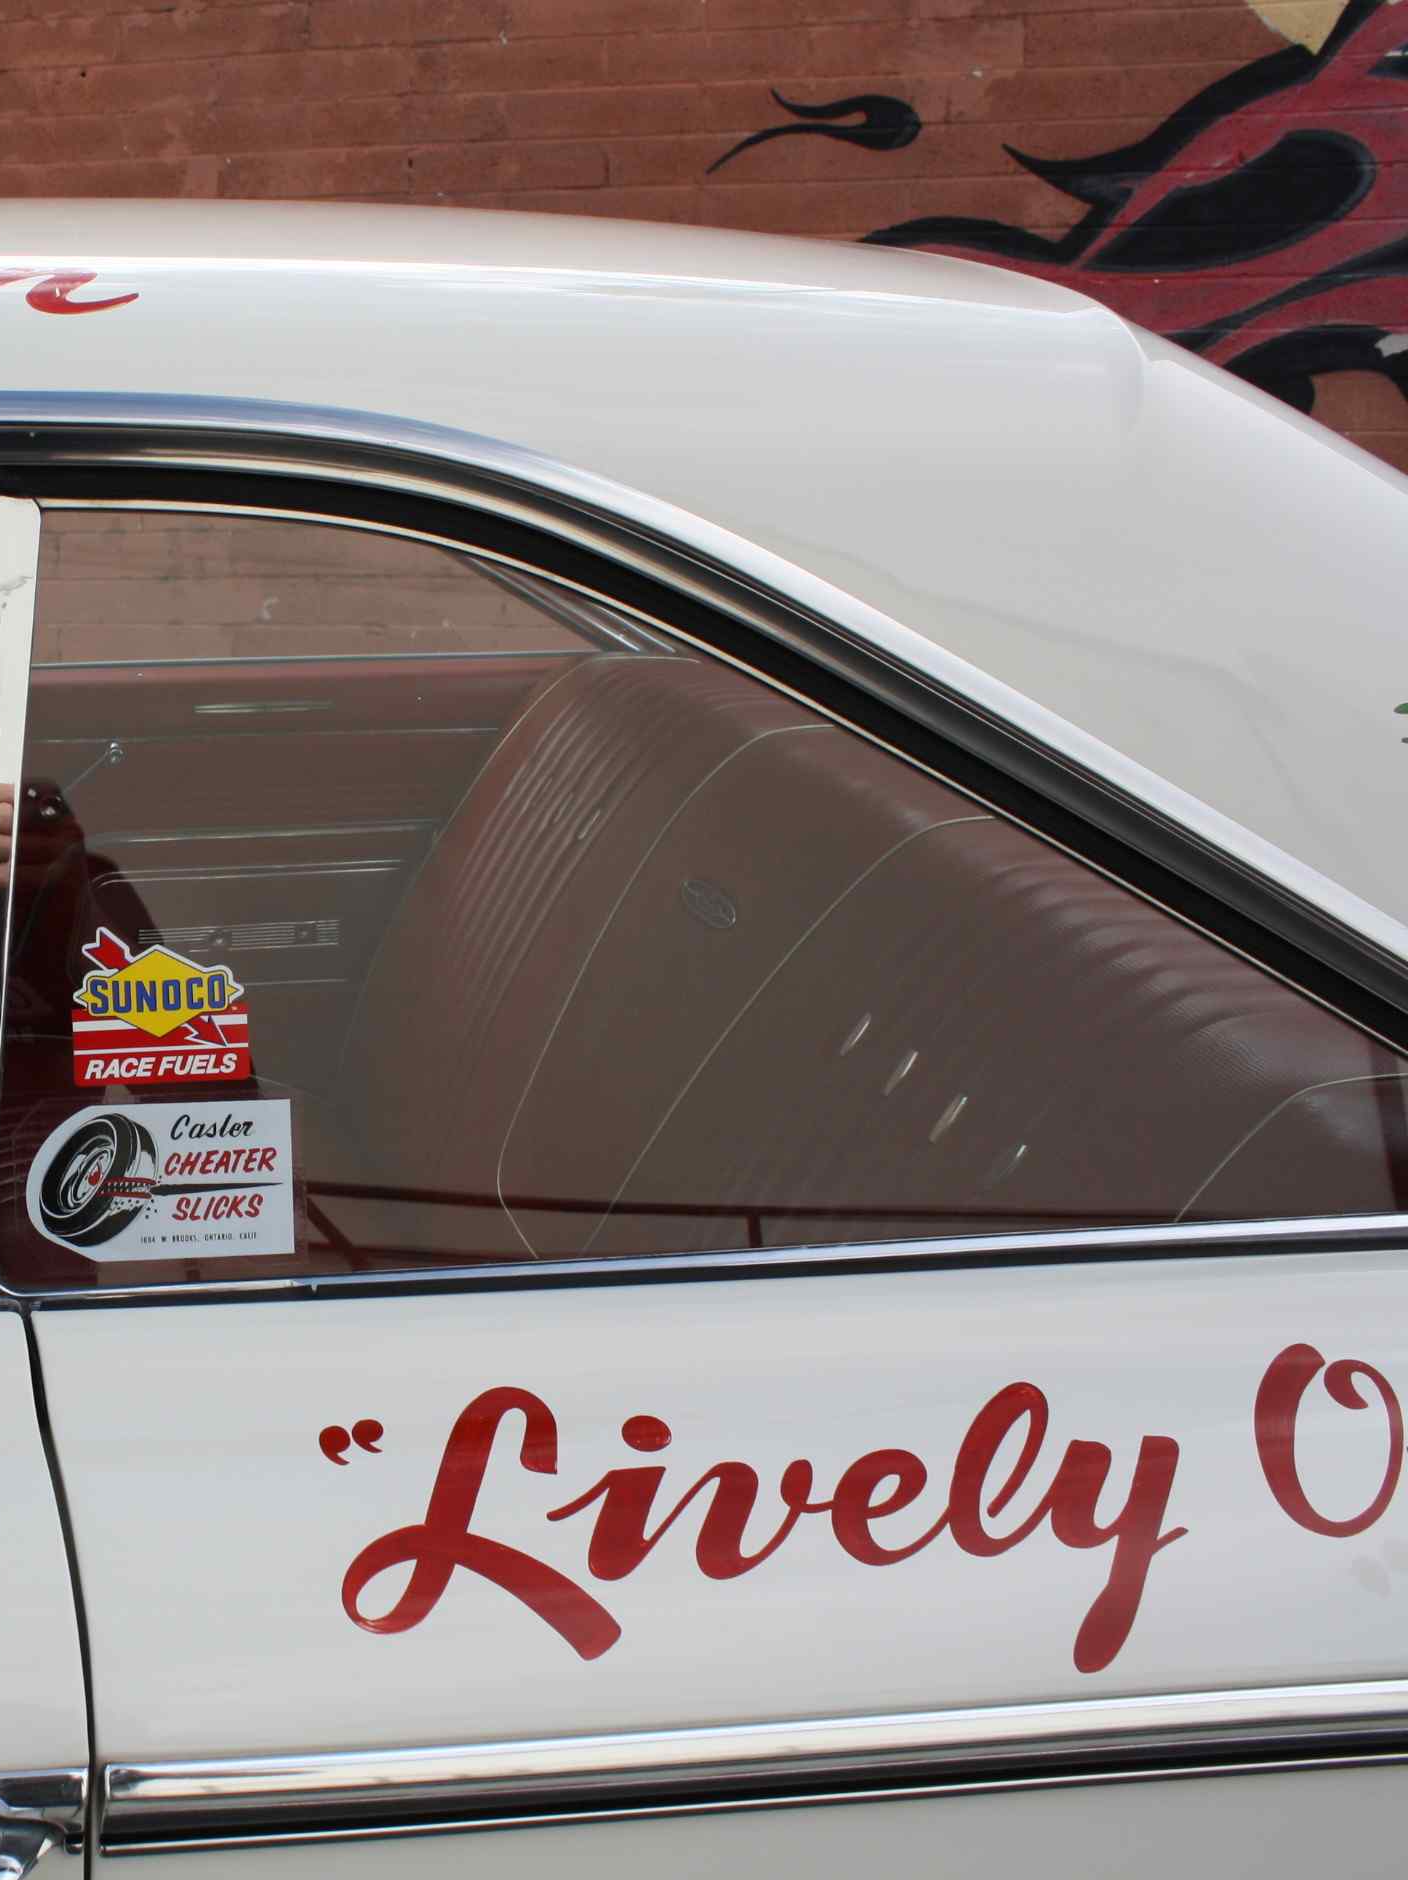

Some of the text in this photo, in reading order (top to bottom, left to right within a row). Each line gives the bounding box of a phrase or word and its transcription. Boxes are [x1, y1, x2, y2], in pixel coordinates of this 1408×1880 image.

[90, 974, 226, 1014] SUNOCO
[84, 1053, 238, 1079] RACE FUELS
[169, 1113, 254, 1141] Casler
[163, 1147, 278, 1177] CHEATER
[171, 1194, 265, 1222] SLICKS
